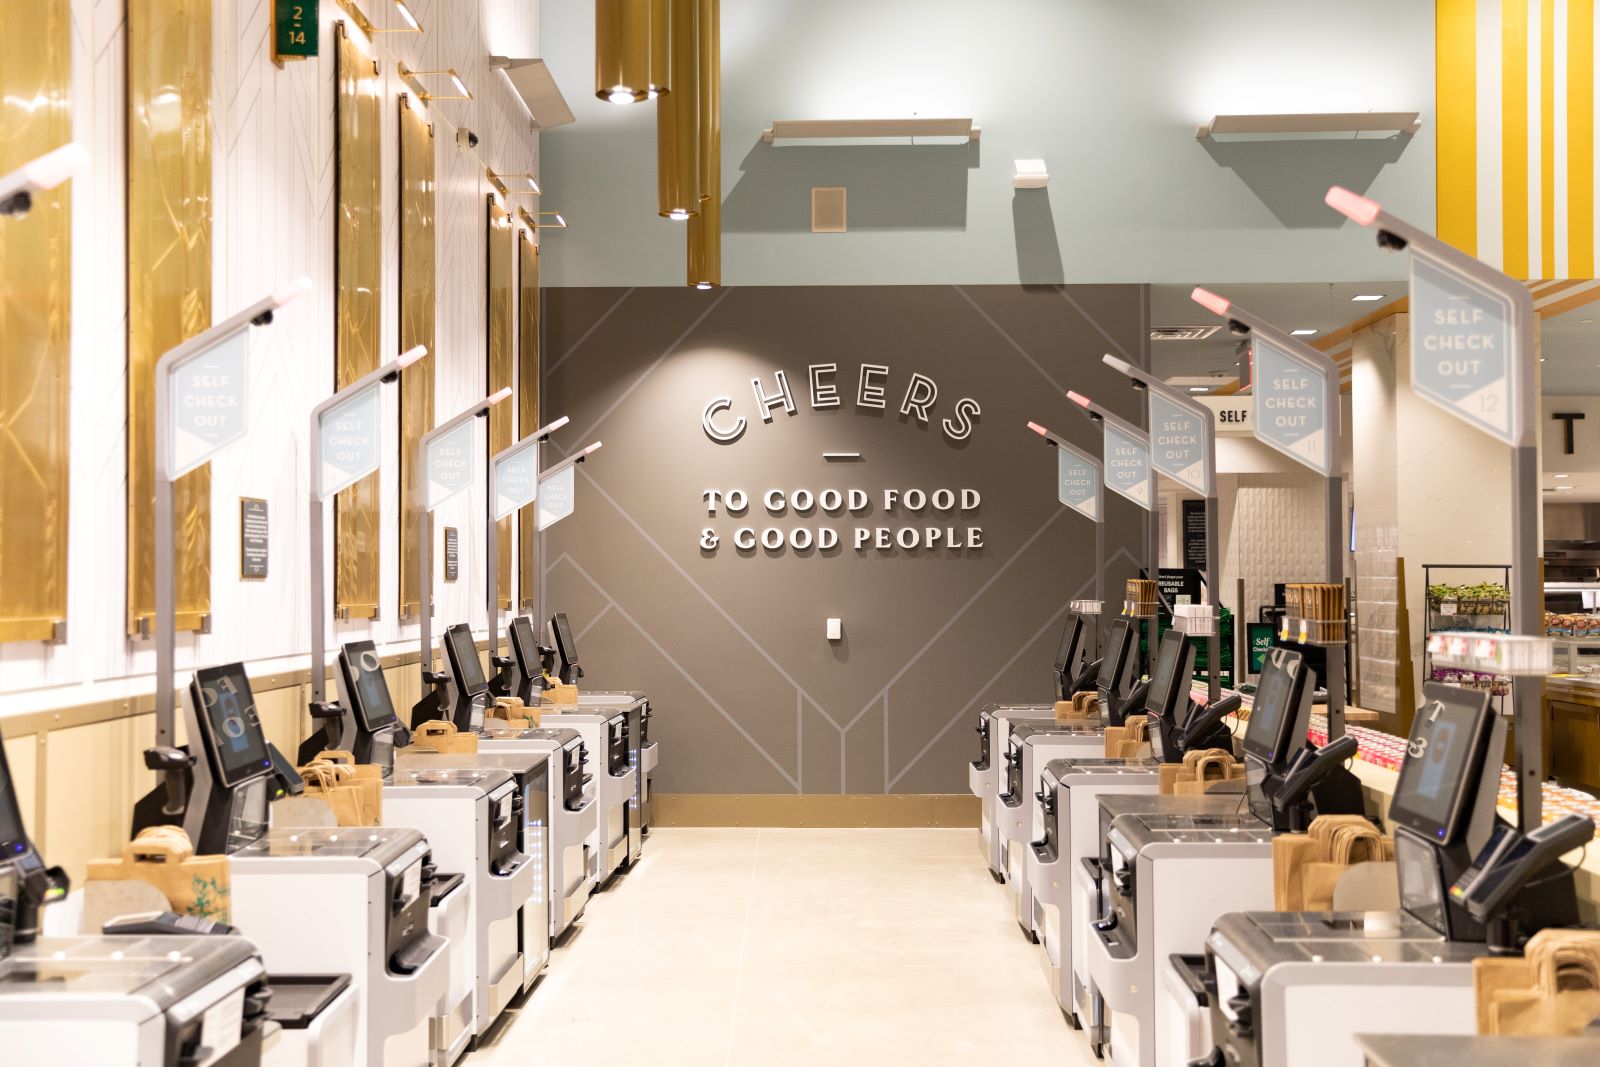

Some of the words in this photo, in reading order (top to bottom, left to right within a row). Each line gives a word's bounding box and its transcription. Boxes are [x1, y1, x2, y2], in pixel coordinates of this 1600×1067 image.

[293, 6, 303, 20] 2
[288, 31, 306, 45] 14
[1433, 308, 1484, 325] SELF
[1423, 334, 1495, 351] CHECK
[1437, 360, 1482, 376] OUT
[192, 375, 231, 388] SELF
[1273, 379, 1309, 391] SELF
[184, 395, 238, 408] CHECK
[702, 362, 981, 441] CHEERS
[1265, 397, 1317, 409] CHECK
[1479, 393, 1500, 412] 12
[194, 414, 228, 428] OUT
[1219, 410, 1248, 423] SELF
[1275, 415, 1307, 427] OUT
[335, 420, 364, 432] SELF
[1163, 422, 1191, 432] SELF
[1552, 412, 1586, 455] T
[328, 436, 370, 447] CHECK
[1158, 435, 1198, 446] CHECK
[336, 451, 362, 462] OUT
[440, 447, 464, 457] SELF
[1115, 447, 1138, 456] SELF
[1166, 450, 1190, 460] OUT
[434, 460, 467, 469] CHECK
[1110, 459, 1143, 468] CHECK
[440, 472, 462, 481] OUT
[1068, 469, 1088, 477] SELF
[1116, 471, 1137, 479] OUT
[1064, 479, 1091, 487] CHECK
[703, 488, 748, 511] TO
[764, 488, 868, 511] GOOD
[884, 488, 981, 510] FOOD
[700, 527, 720, 549] &
[734, 527, 838, 549] GOOD
[854, 527, 983, 549] PEOPLE
[1256, 637, 1270, 647] Self
